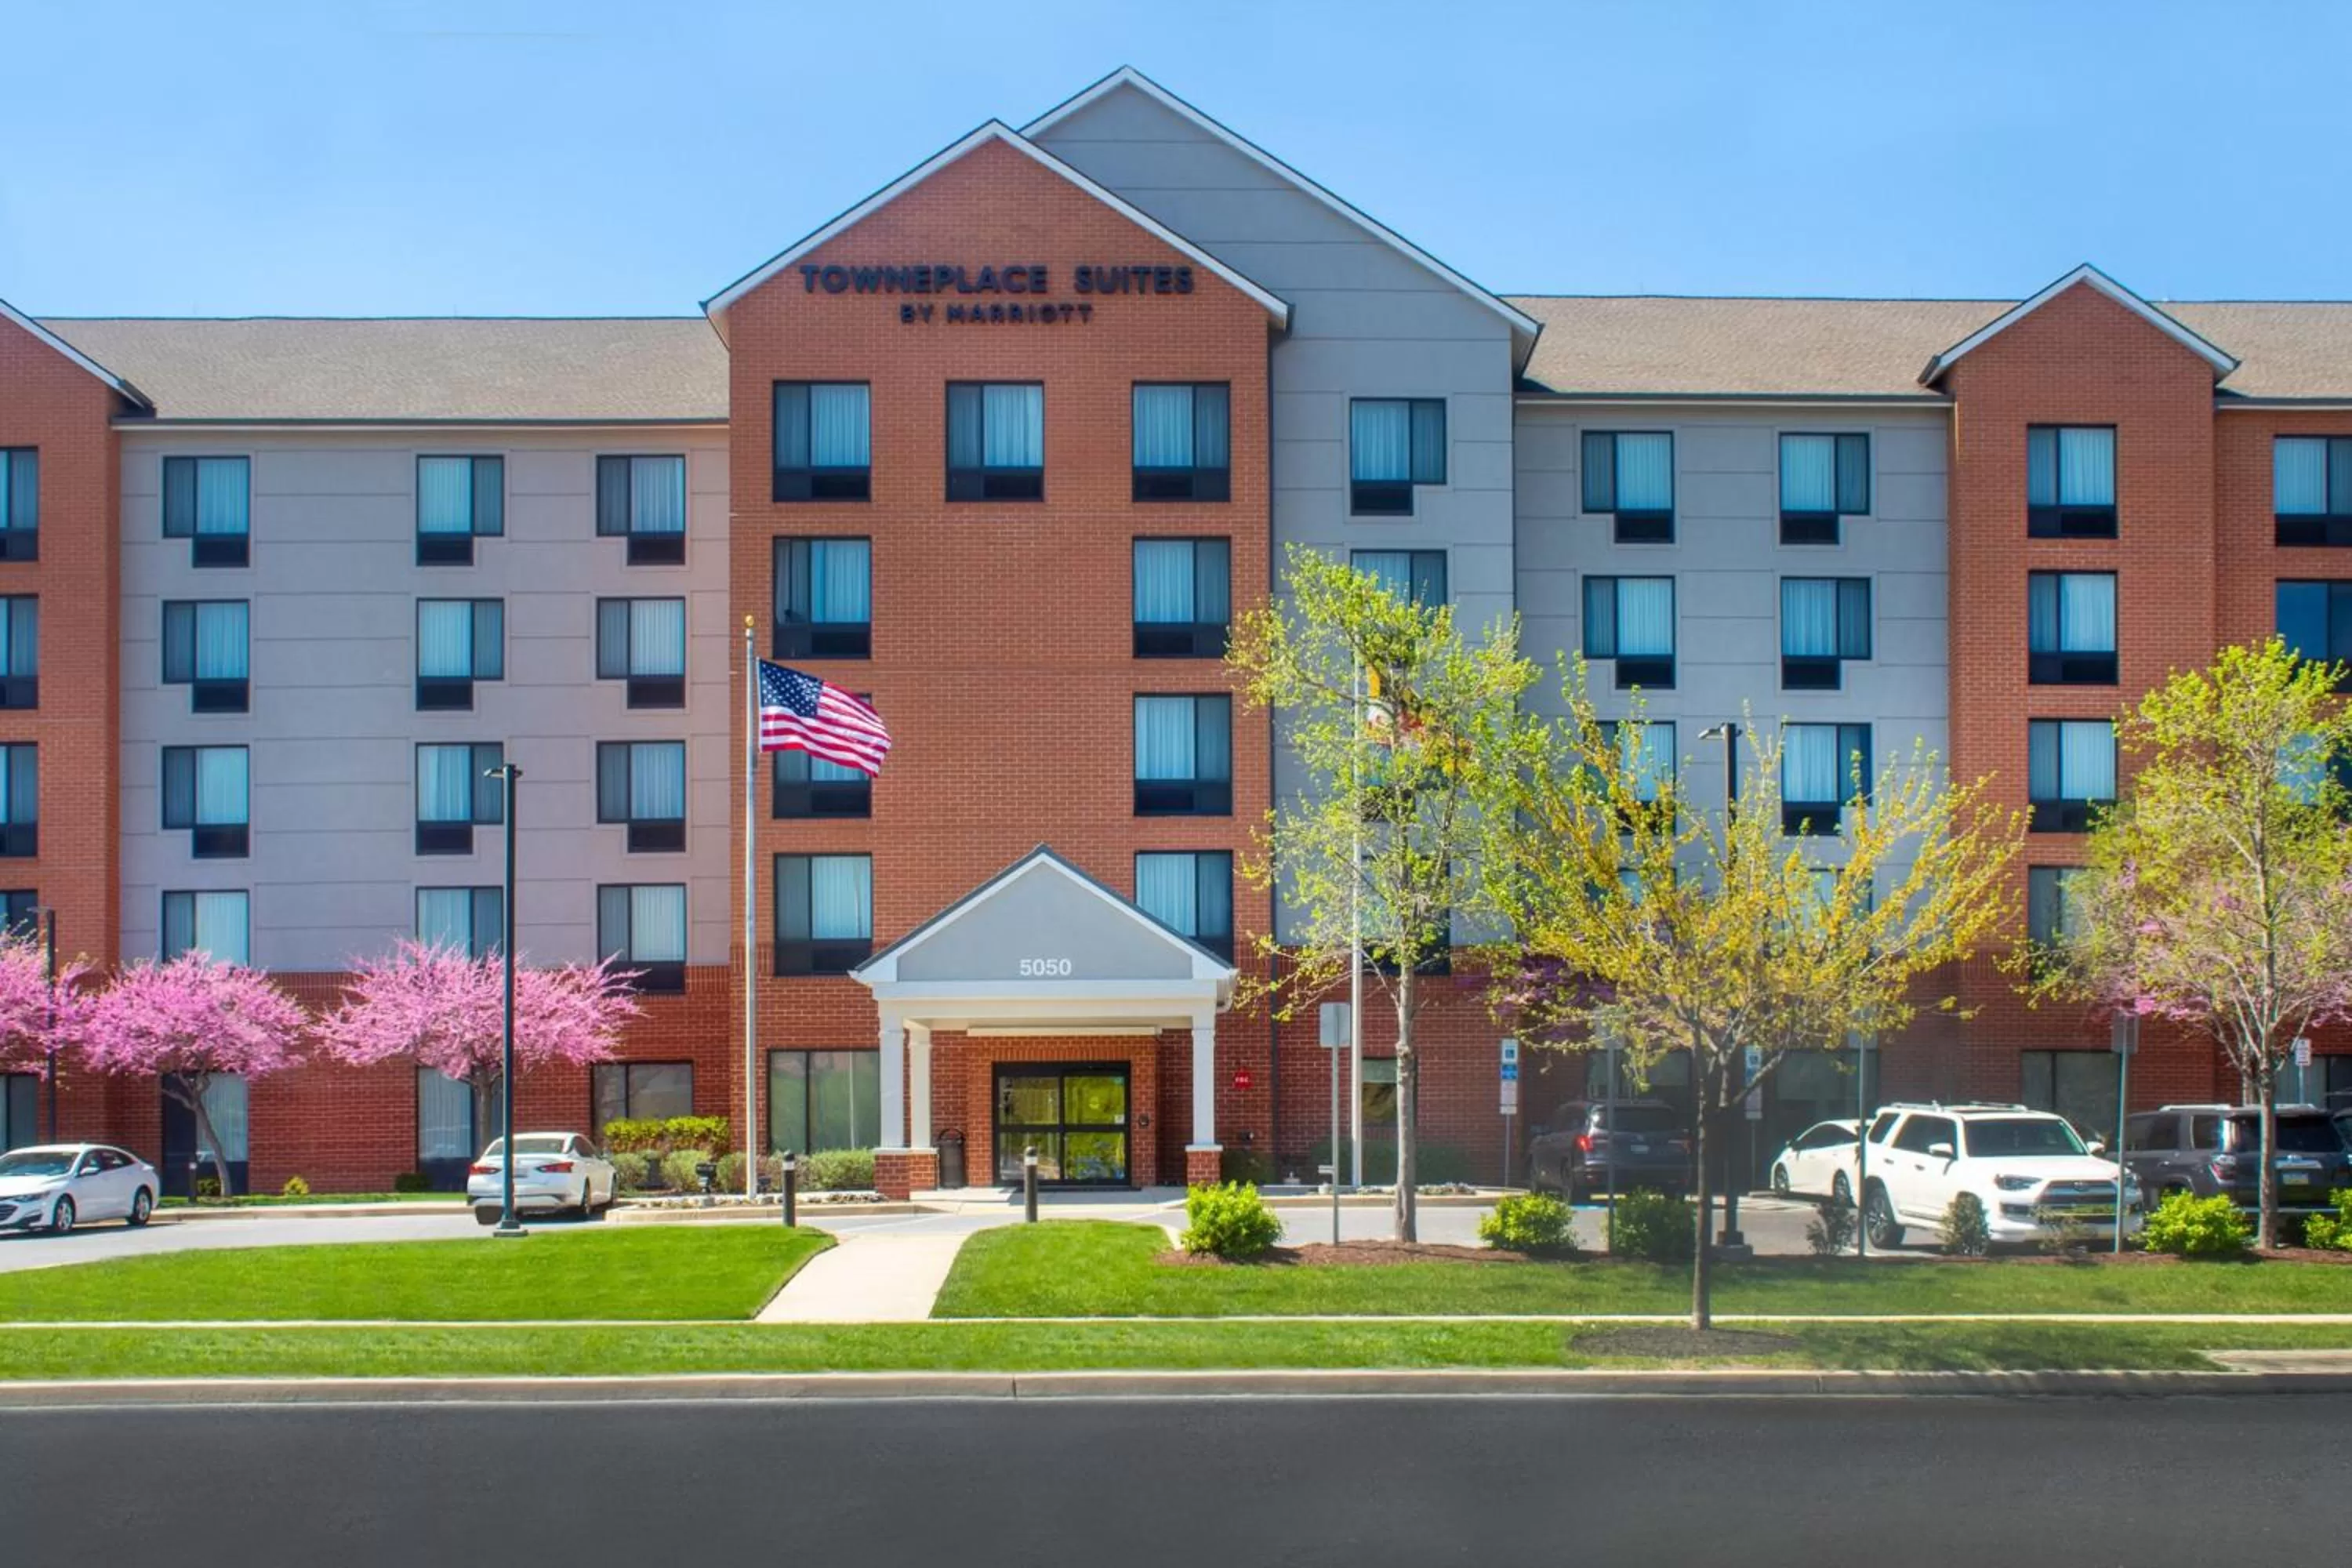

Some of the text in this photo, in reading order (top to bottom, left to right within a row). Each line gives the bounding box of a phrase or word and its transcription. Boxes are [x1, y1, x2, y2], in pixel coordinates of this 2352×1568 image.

[800, 264, 1193, 294] TOWNEPLACE SUITES
[900, 303, 1093, 324] BY MARRIOTT
[1020, 959, 1072, 976] 5050
